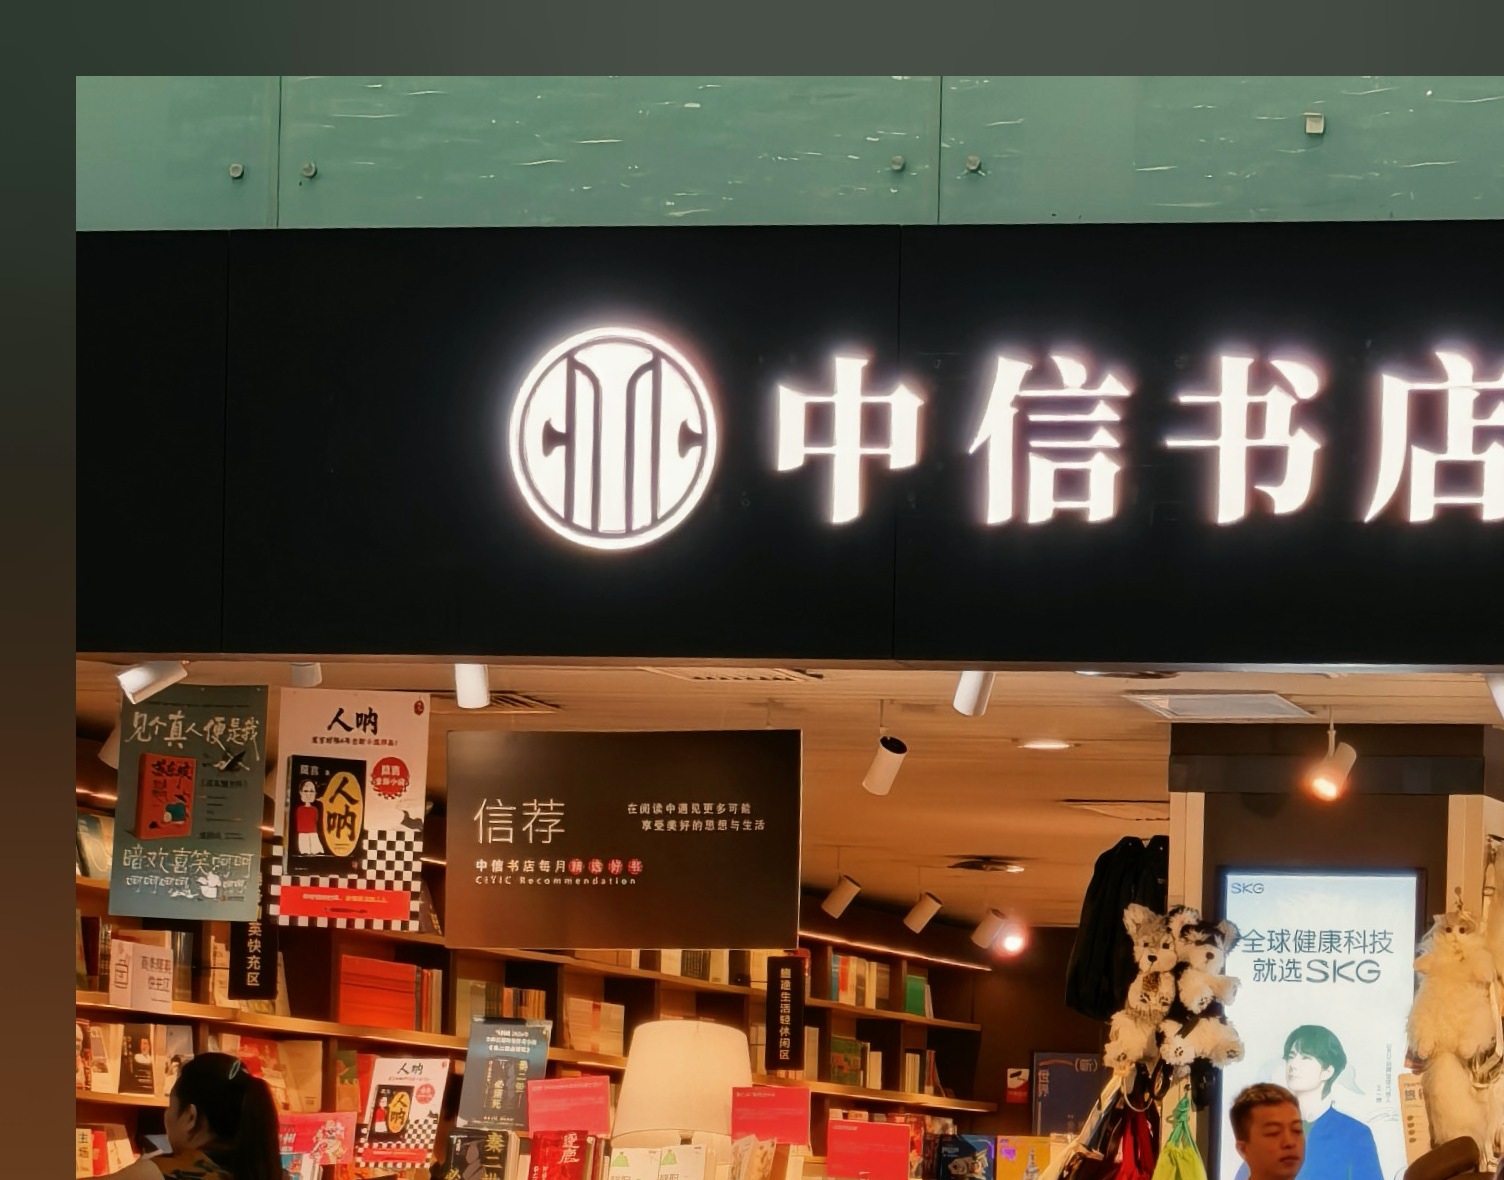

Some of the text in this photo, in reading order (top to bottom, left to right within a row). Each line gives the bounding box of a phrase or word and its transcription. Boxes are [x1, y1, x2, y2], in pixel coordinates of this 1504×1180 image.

[327, 706, 379, 736] 人呐
[326, 776, 360, 842] 人呐
[473, 797, 566, 844] 信荐
[1230, 882, 1265, 895] SKG
[1240, 928, 1395, 956] 全球健康科技
[1252, 957, 1383, 985] 就选SKG
